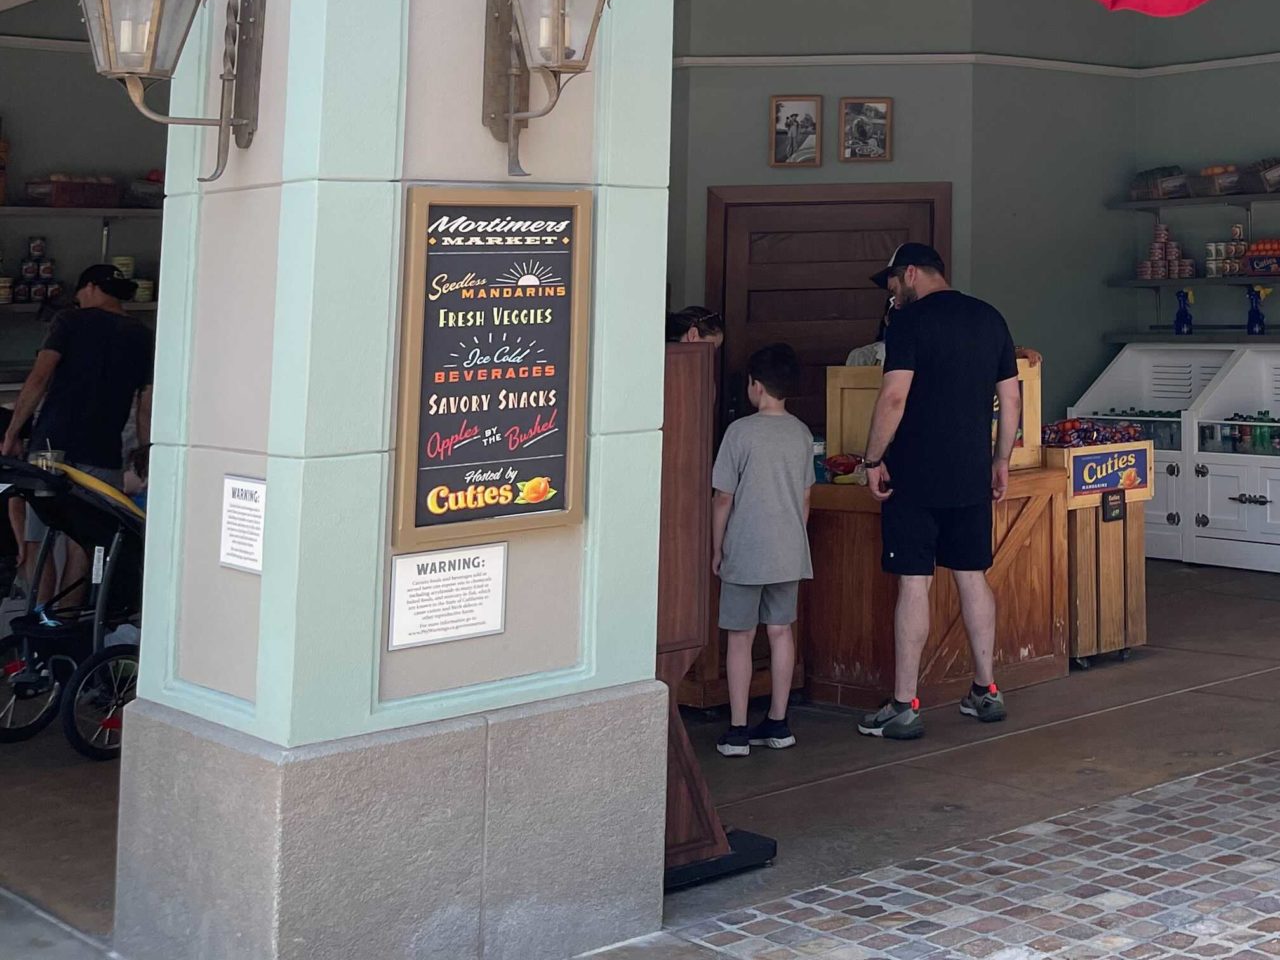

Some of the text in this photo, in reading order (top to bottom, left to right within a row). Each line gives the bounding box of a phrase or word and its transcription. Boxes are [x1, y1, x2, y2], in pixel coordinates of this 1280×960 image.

[427, 215, 571, 234] Mortimers
[441, 236, 557, 245] MARKET
[428, 272, 487, 300] Seedless
[461, 287, 566, 299] MANDARINS
[438, 307, 552, 328] FRESH VEGGIES
[463, 346, 529, 368] Ice Cold
[434, 365, 555, 383] BEVERAGES
[428, 389, 556, 416] SAVORY SNACKS
[482, 433, 502, 445] THE
[484, 426, 498, 437] BY
[504, 408, 558, 451] Bushel
[426, 419, 480, 461] Apples
[465, 467, 518, 483] Hosted by
[1083, 453, 1136, 484] Cuties
[231, 486, 260, 503] WARNING:
[426, 483, 513, 515] Cuties
[416, 556, 485, 575] WARNING:
